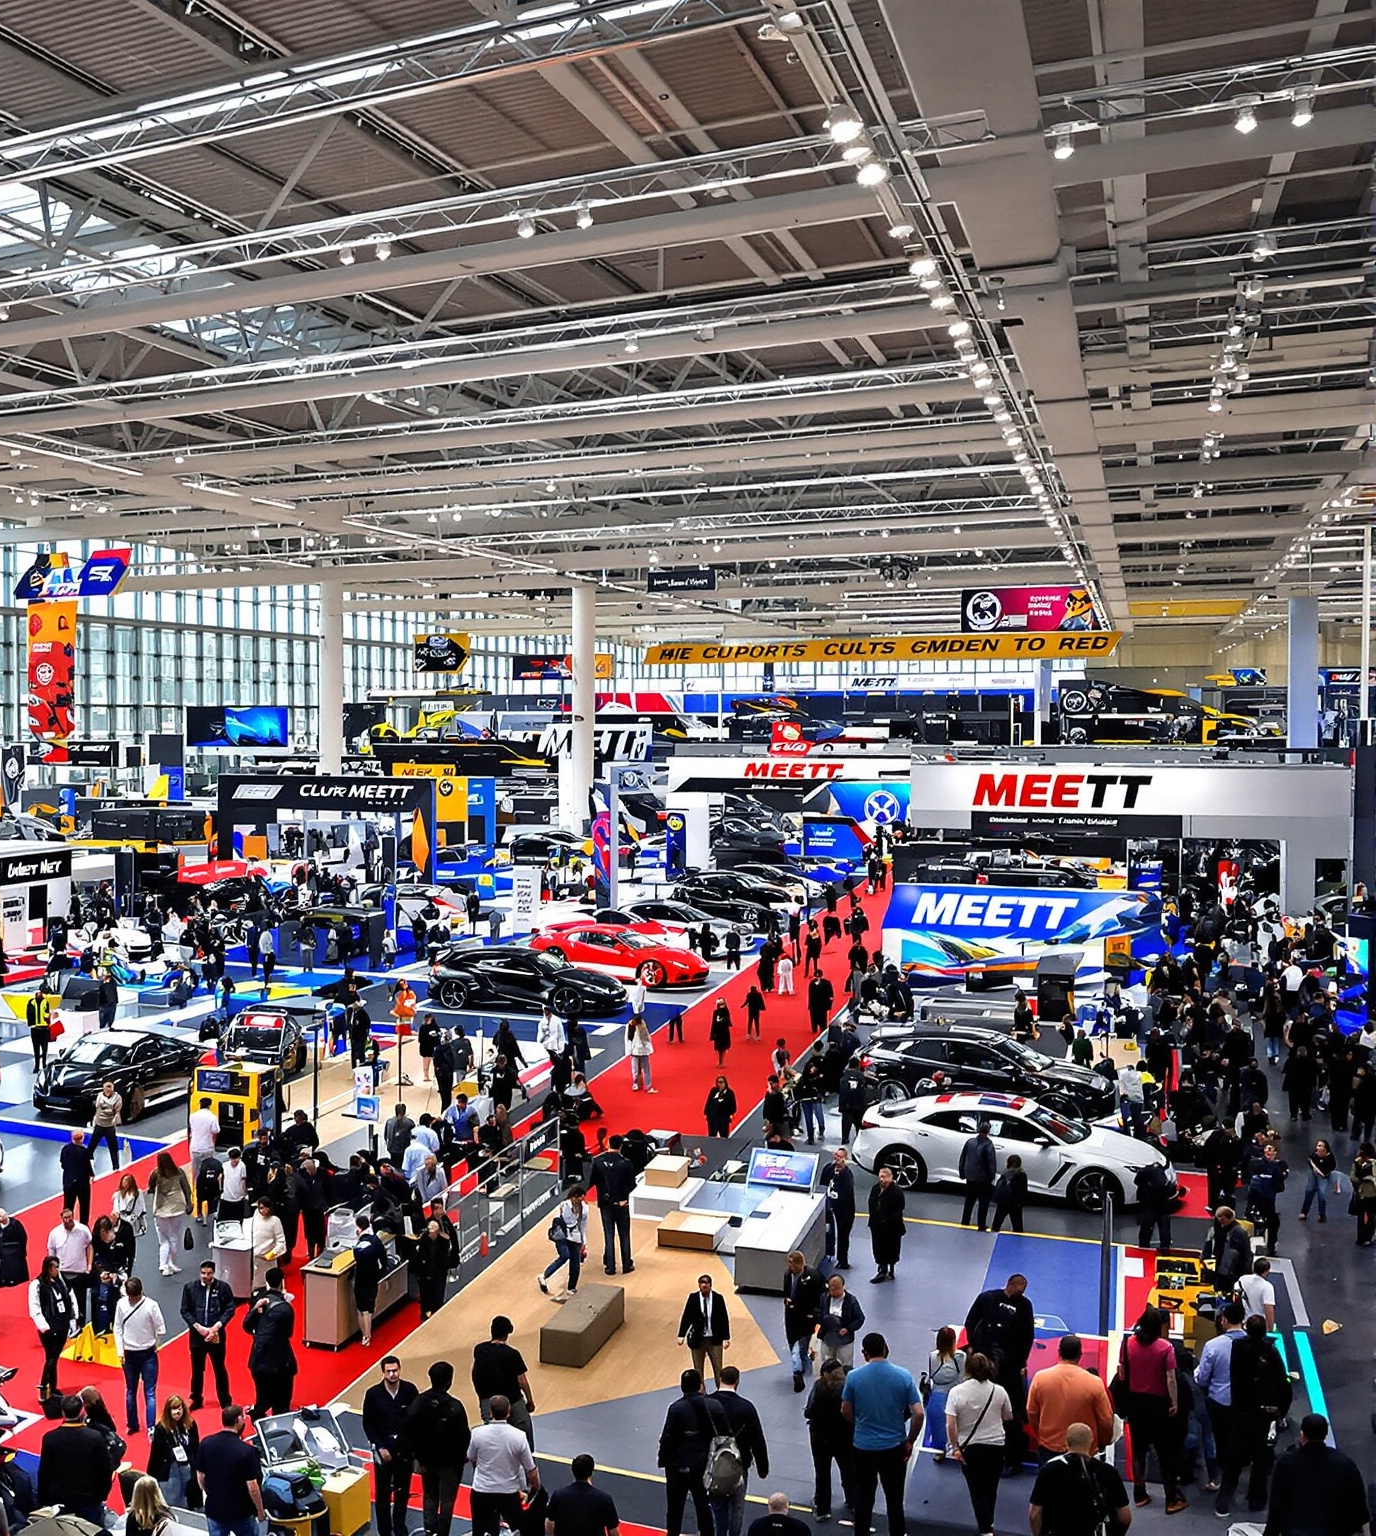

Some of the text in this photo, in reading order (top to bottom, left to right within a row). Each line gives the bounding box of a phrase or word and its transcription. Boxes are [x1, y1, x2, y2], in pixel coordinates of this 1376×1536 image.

[824, 641, 896, 656] CULTS
[1013, 636, 1047, 652] TO
[1058, 635, 1109, 651] RED
[744, 763, 845, 779] MEETT
[348, 784, 415, 799] MEETT
[972, 773, 1154, 809] MEETT
[911, 892, 1080, 930] MEETT
